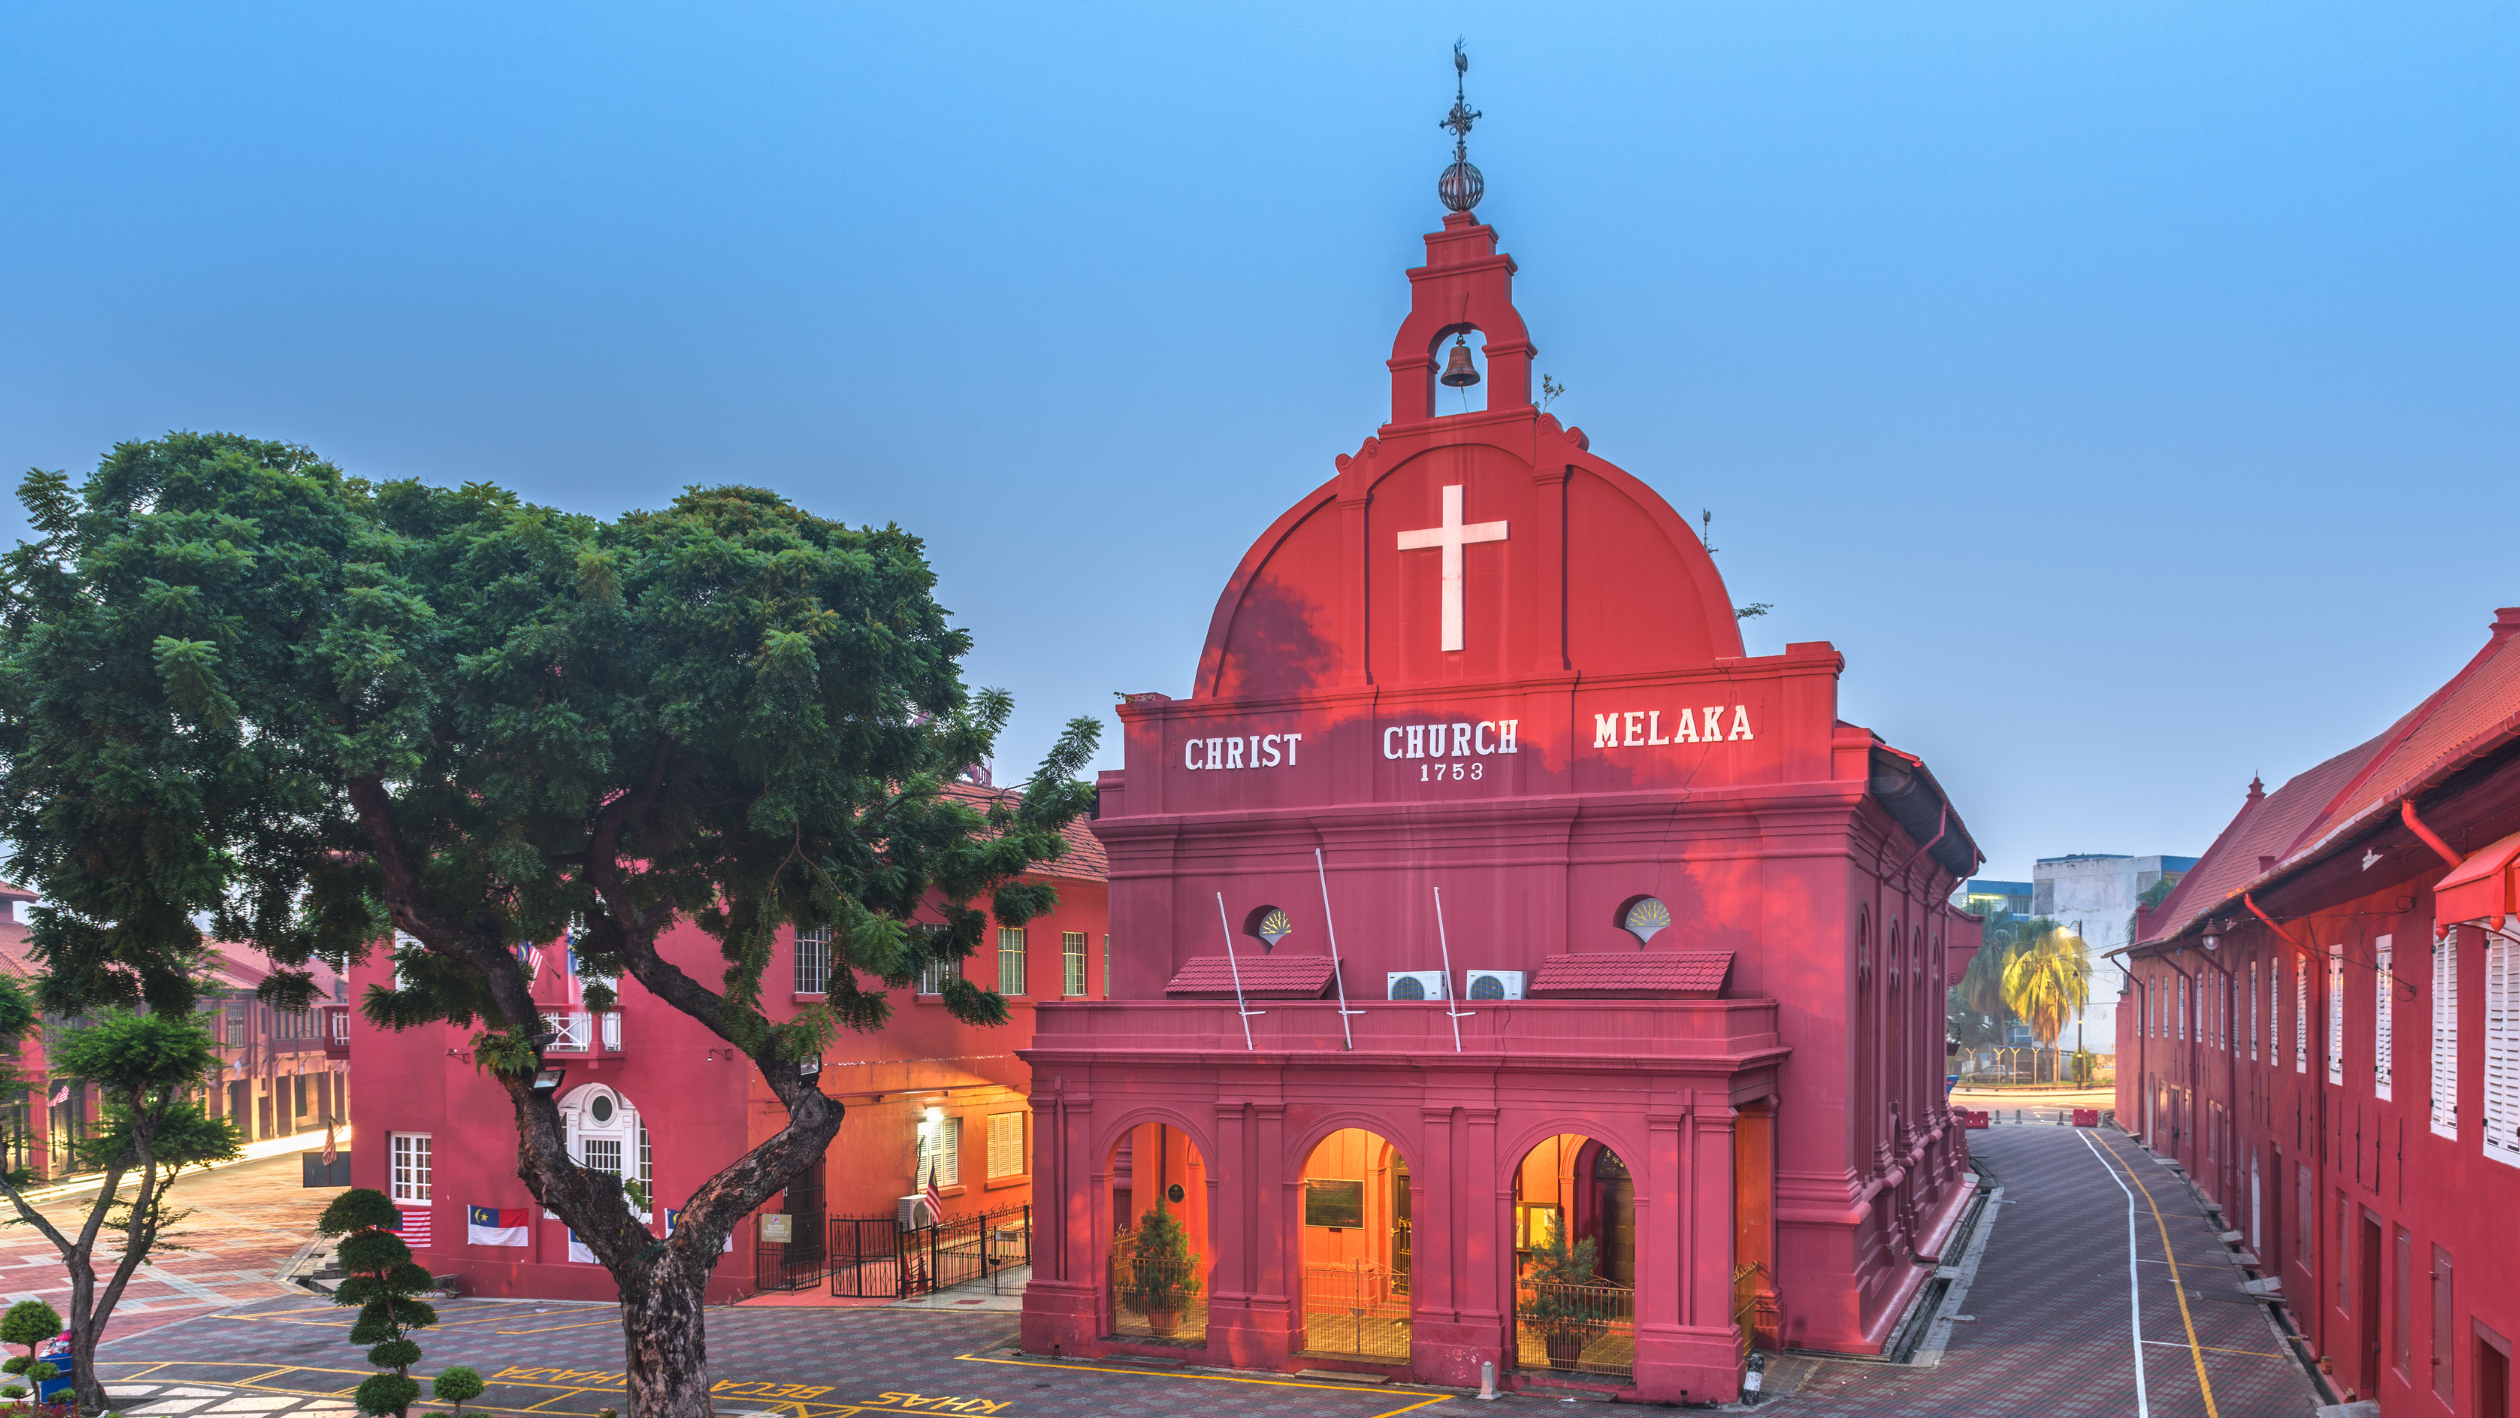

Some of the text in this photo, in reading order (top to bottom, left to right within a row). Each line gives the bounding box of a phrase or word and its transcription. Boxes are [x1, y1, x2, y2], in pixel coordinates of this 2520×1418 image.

[1185, 704, 1755, 770] CHRIST CHURCH MELAKA
[1420, 762, 1484, 782] 1753
[491, 1365, 1012, 1414] KHAS BECA HAJA
